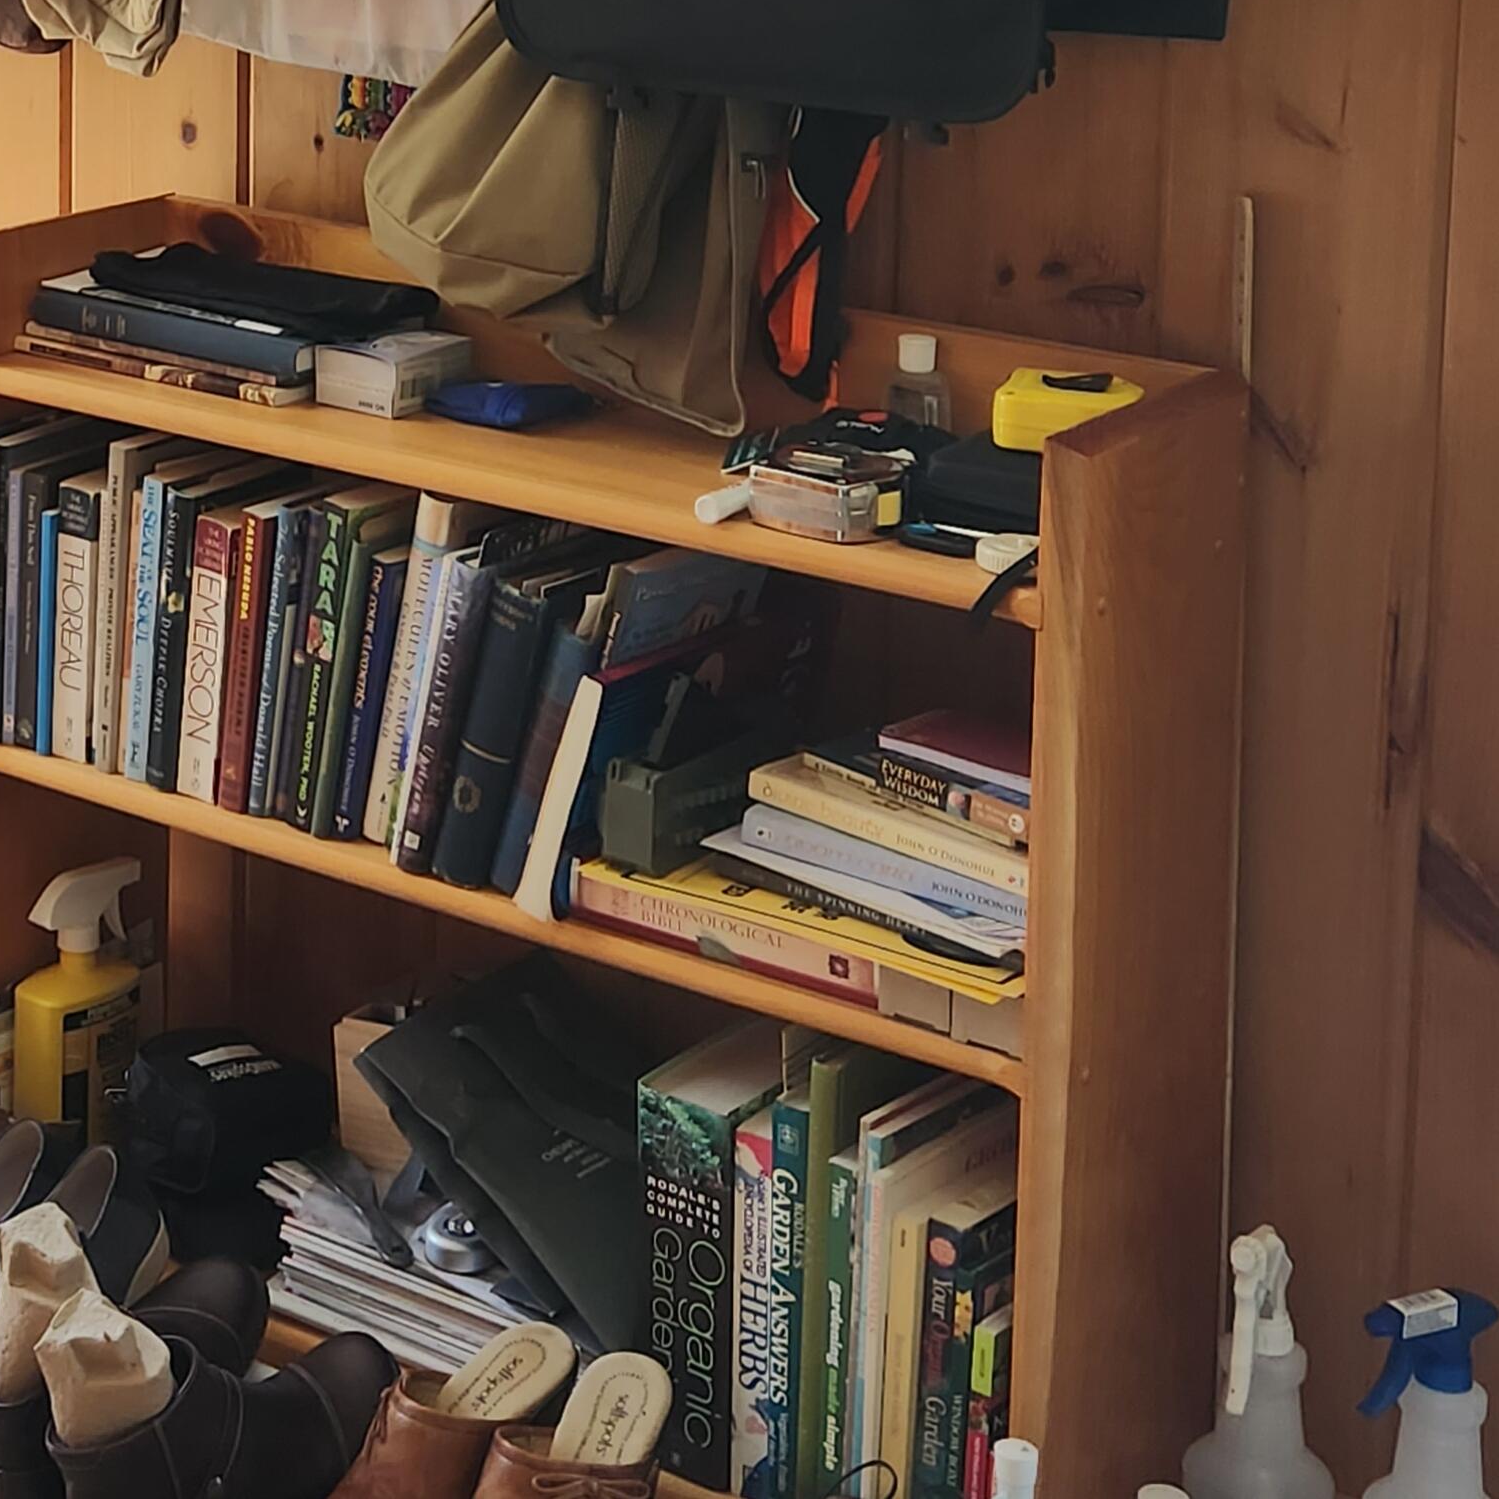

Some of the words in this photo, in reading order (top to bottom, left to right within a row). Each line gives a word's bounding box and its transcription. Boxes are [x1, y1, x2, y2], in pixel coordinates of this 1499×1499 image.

[141, 508, 157, 558] SEAT
[244, 517, 256, 562] PABLO
[239, 564, 252, 619] NERUDA
[270, 554, 285, 616] Selected
[315, 512, 342, 615] TARA
[58, 549, 85, 692] THOREAU
[136, 588, 153, 645] SOUL
[404, 558, 433, 671] MOLECULES
[443, 591, 463, 644] MARY
[156, 615, 172, 674] DEEPAK
[186, 573, 221, 744] EMERSON
[263, 620, 279, 670] Poems
[152, 676, 168, 733] CHOPRA
[307, 663, 321, 717] RACHAEL
[426, 653, 451, 728] OLIVER
[255, 691, 272, 750] Donald
[387, 696, 410, 786] EMOTION
[250, 752, 266, 786] Hall
[880, 758, 947, 795] EVERYDAY
[883, 771, 940, 807] WISDOM
[896, 833, 925, 851] JOHN
[786, 883, 811, 899] THE
[816, 889, 880, 921] SPINNING
[931, 881, 963, 899] JOHN
[639, 895, 786, 949] CHRONOLOGICAL
[641, 911, 684, 933] BIBLE
[646, 1203, 693, 1228] GUIDE
[701, 1223, 720, 1239] TO
[647, 1175, 720, 1211] RODALE'S
[647, 1190, 720, 1225] COMPLETE
[772, 1168, 798, 1276] GARDEN
[652, 1227, 682, 1372] Garden
[826, 1279, 844, 1369] gardening
[930, 1277, 954, 1322] Your
[678, 1240, 725, 1448] Organic
[739, 1273, 769, 1396] HERBS
[770, 1276, 797, 1407] ANSWERS
[823, 1414, 840, 1471] simple
[922, 1395, 947, 1467] Garden
